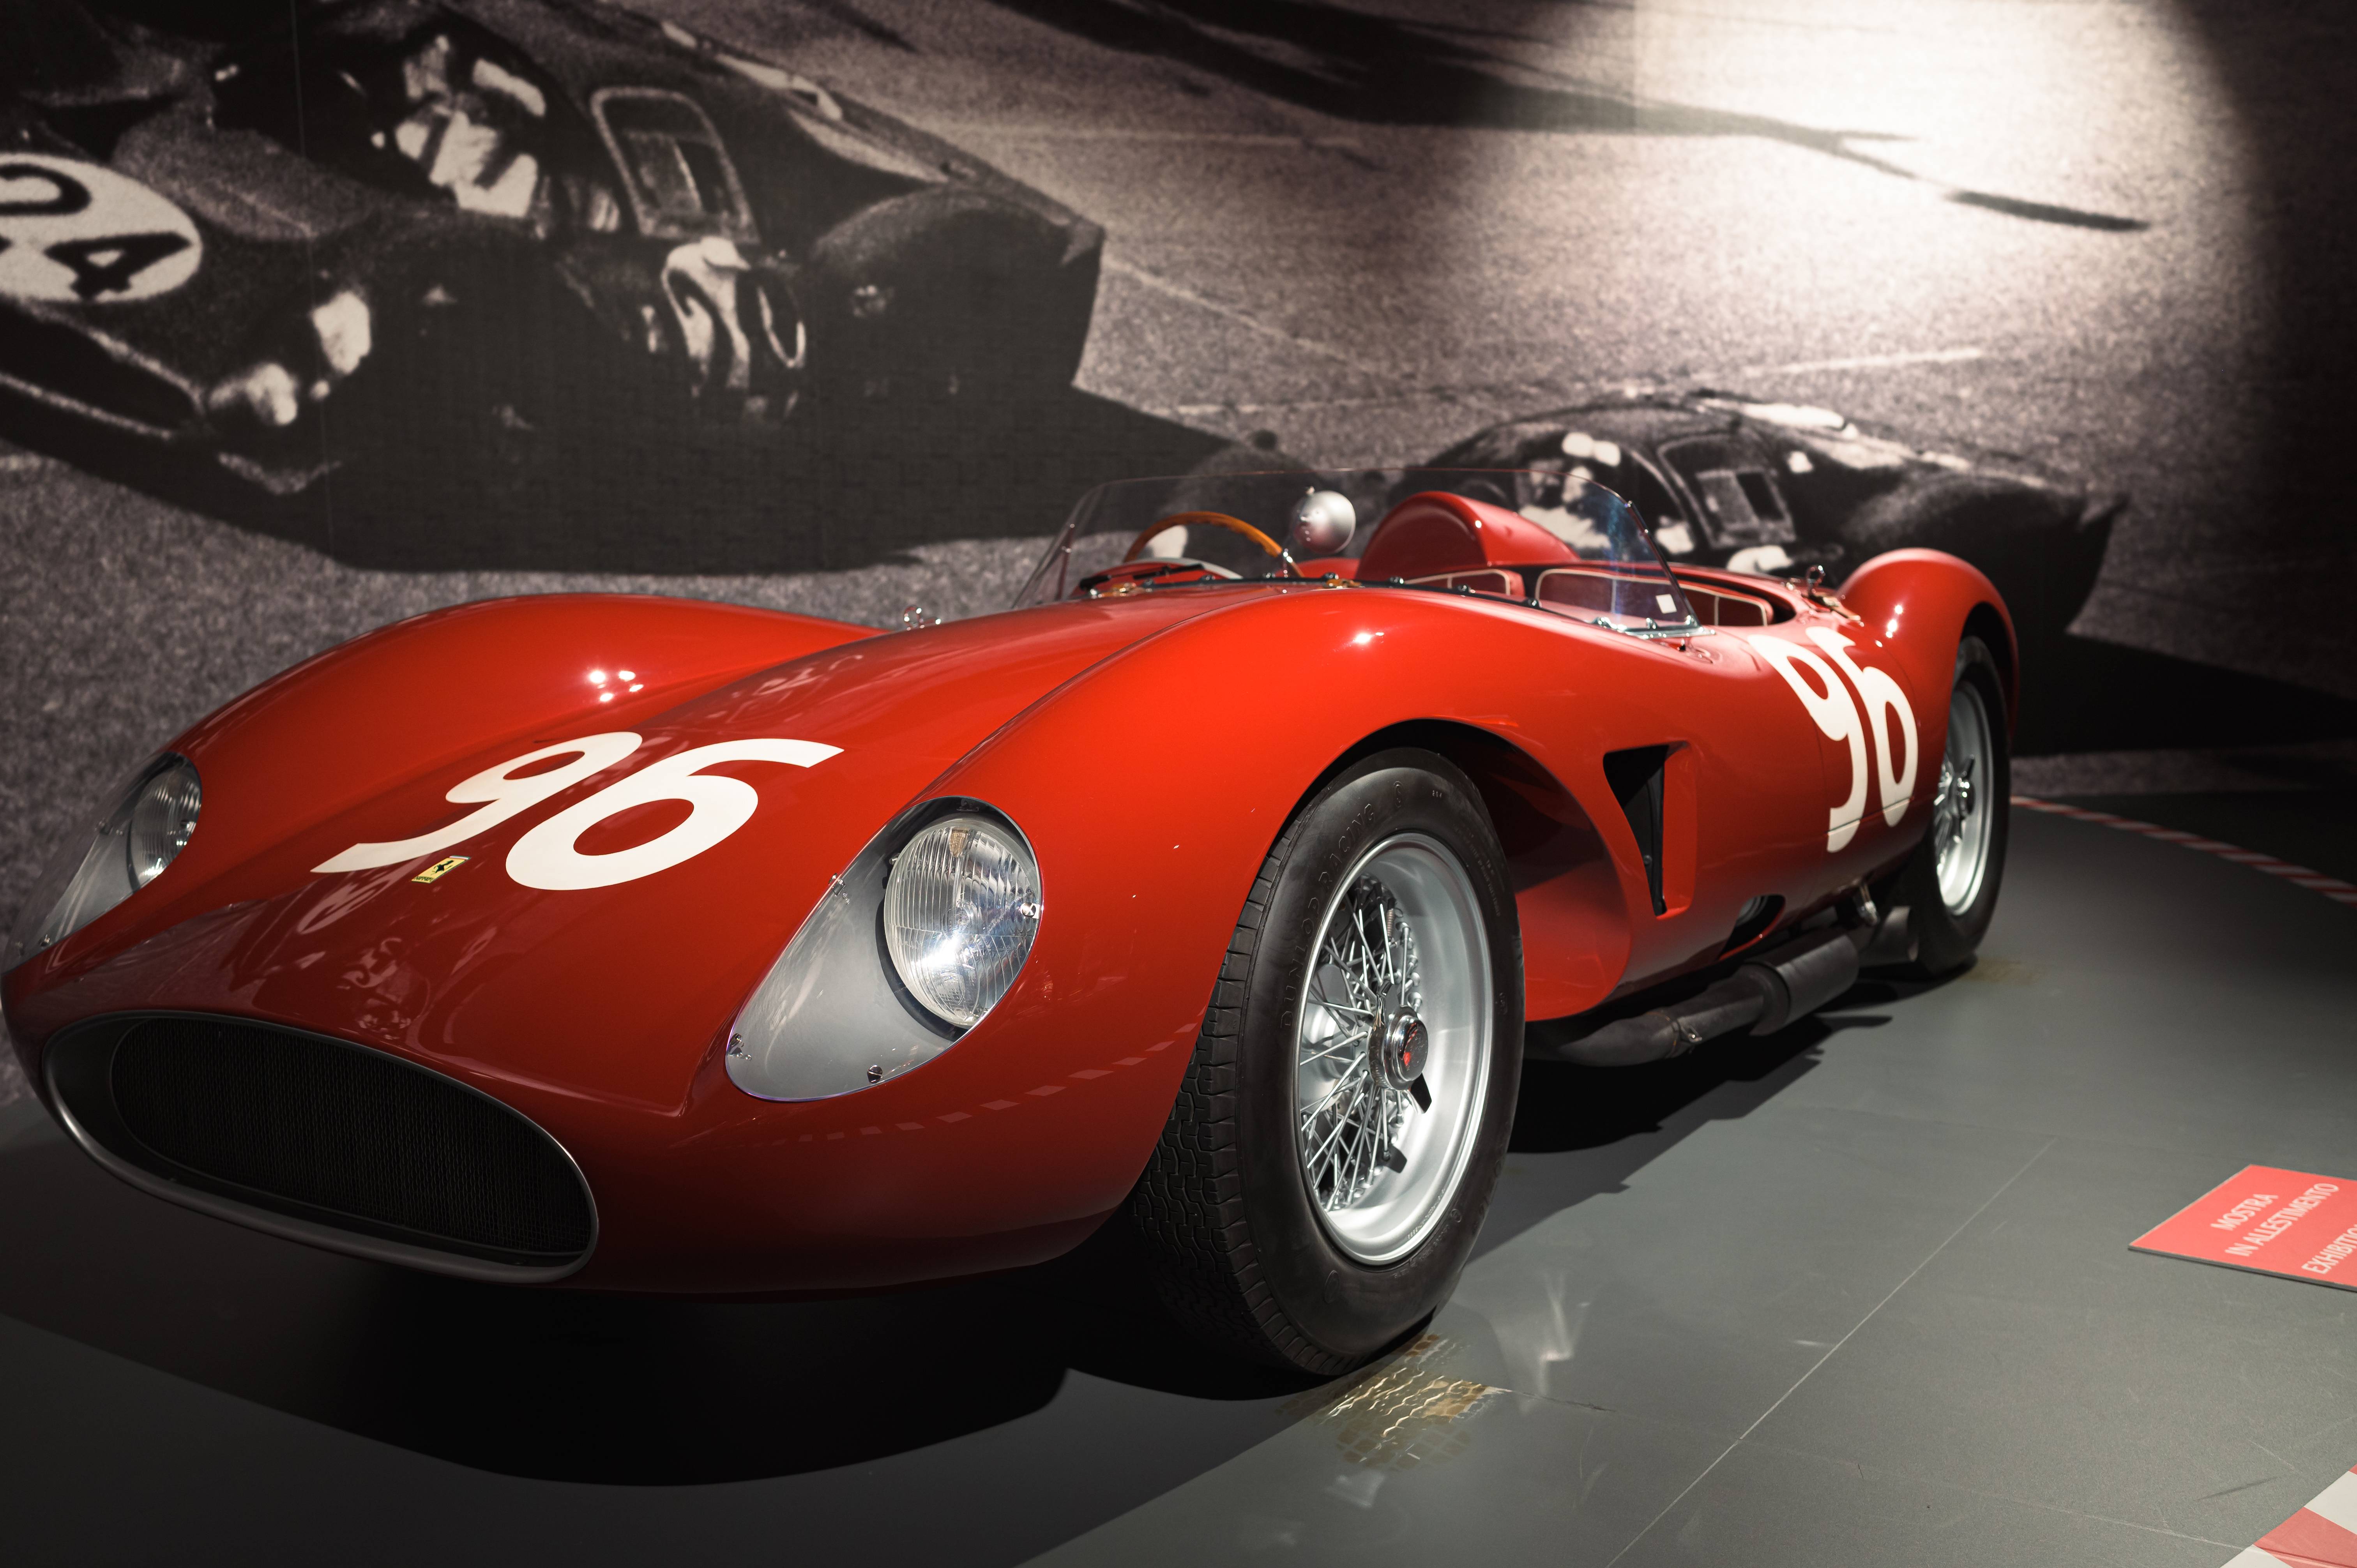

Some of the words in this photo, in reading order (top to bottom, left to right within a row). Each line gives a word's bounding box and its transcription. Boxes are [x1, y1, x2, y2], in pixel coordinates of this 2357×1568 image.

[310, 731, 845, 891] 96
[1747, 626, 1918, 853] 96
[1280, 897, 1320, 1029] DUNLOP
[1318, 803, 1375, 890] RACING
[2210, 1194, 2278, 1231] MOSTRA
[2225, 1243, 2258, 1256] IN
[2243, 1183, 2339, 1246] ALLESTIMENTO
